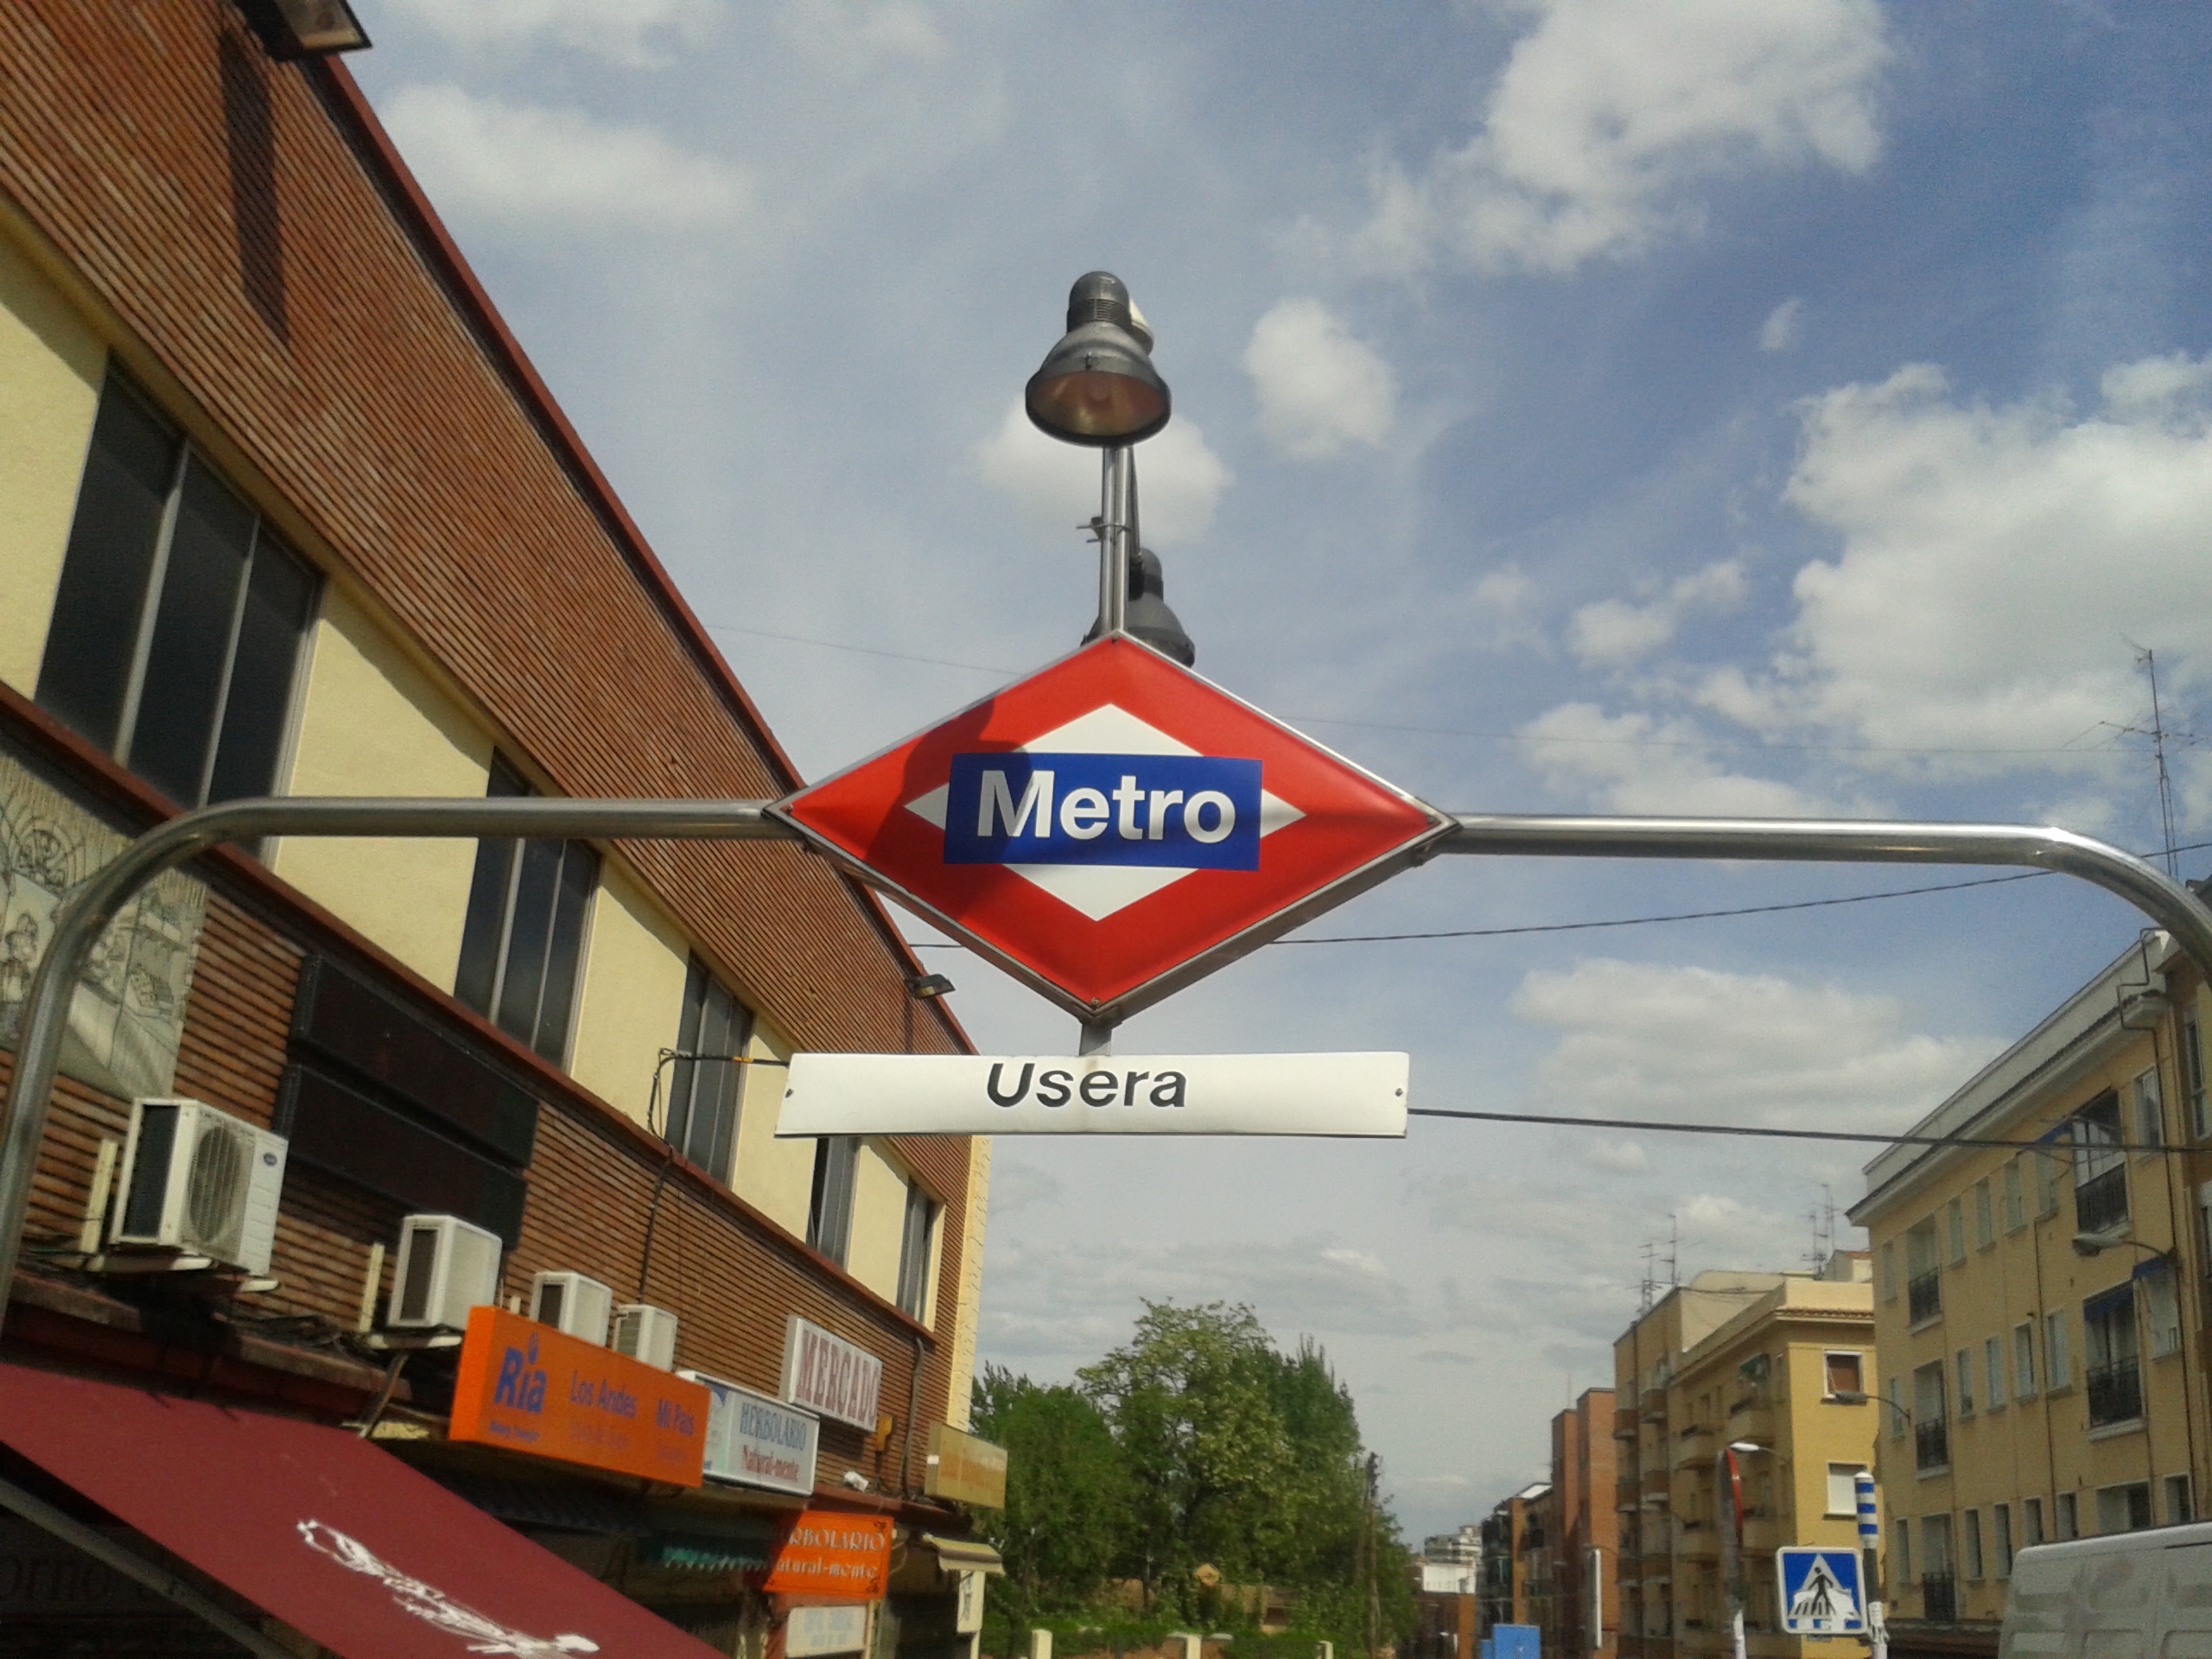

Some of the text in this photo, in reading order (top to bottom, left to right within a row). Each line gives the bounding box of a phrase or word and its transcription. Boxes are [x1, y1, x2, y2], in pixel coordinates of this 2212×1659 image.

[977, 769, 1236, 844] Metro
[986, 1062, 1187, 1109] Usera
[493, 1333, 548, 1414] Ria
[795, 1330, 880, 1426] MERCADO
[740, 1402, 807, 1452] HERBOLARIO
[788, 1527, 885, 1552] RBOLARIO
[776, 1556, 878, 1580] atural-mente
